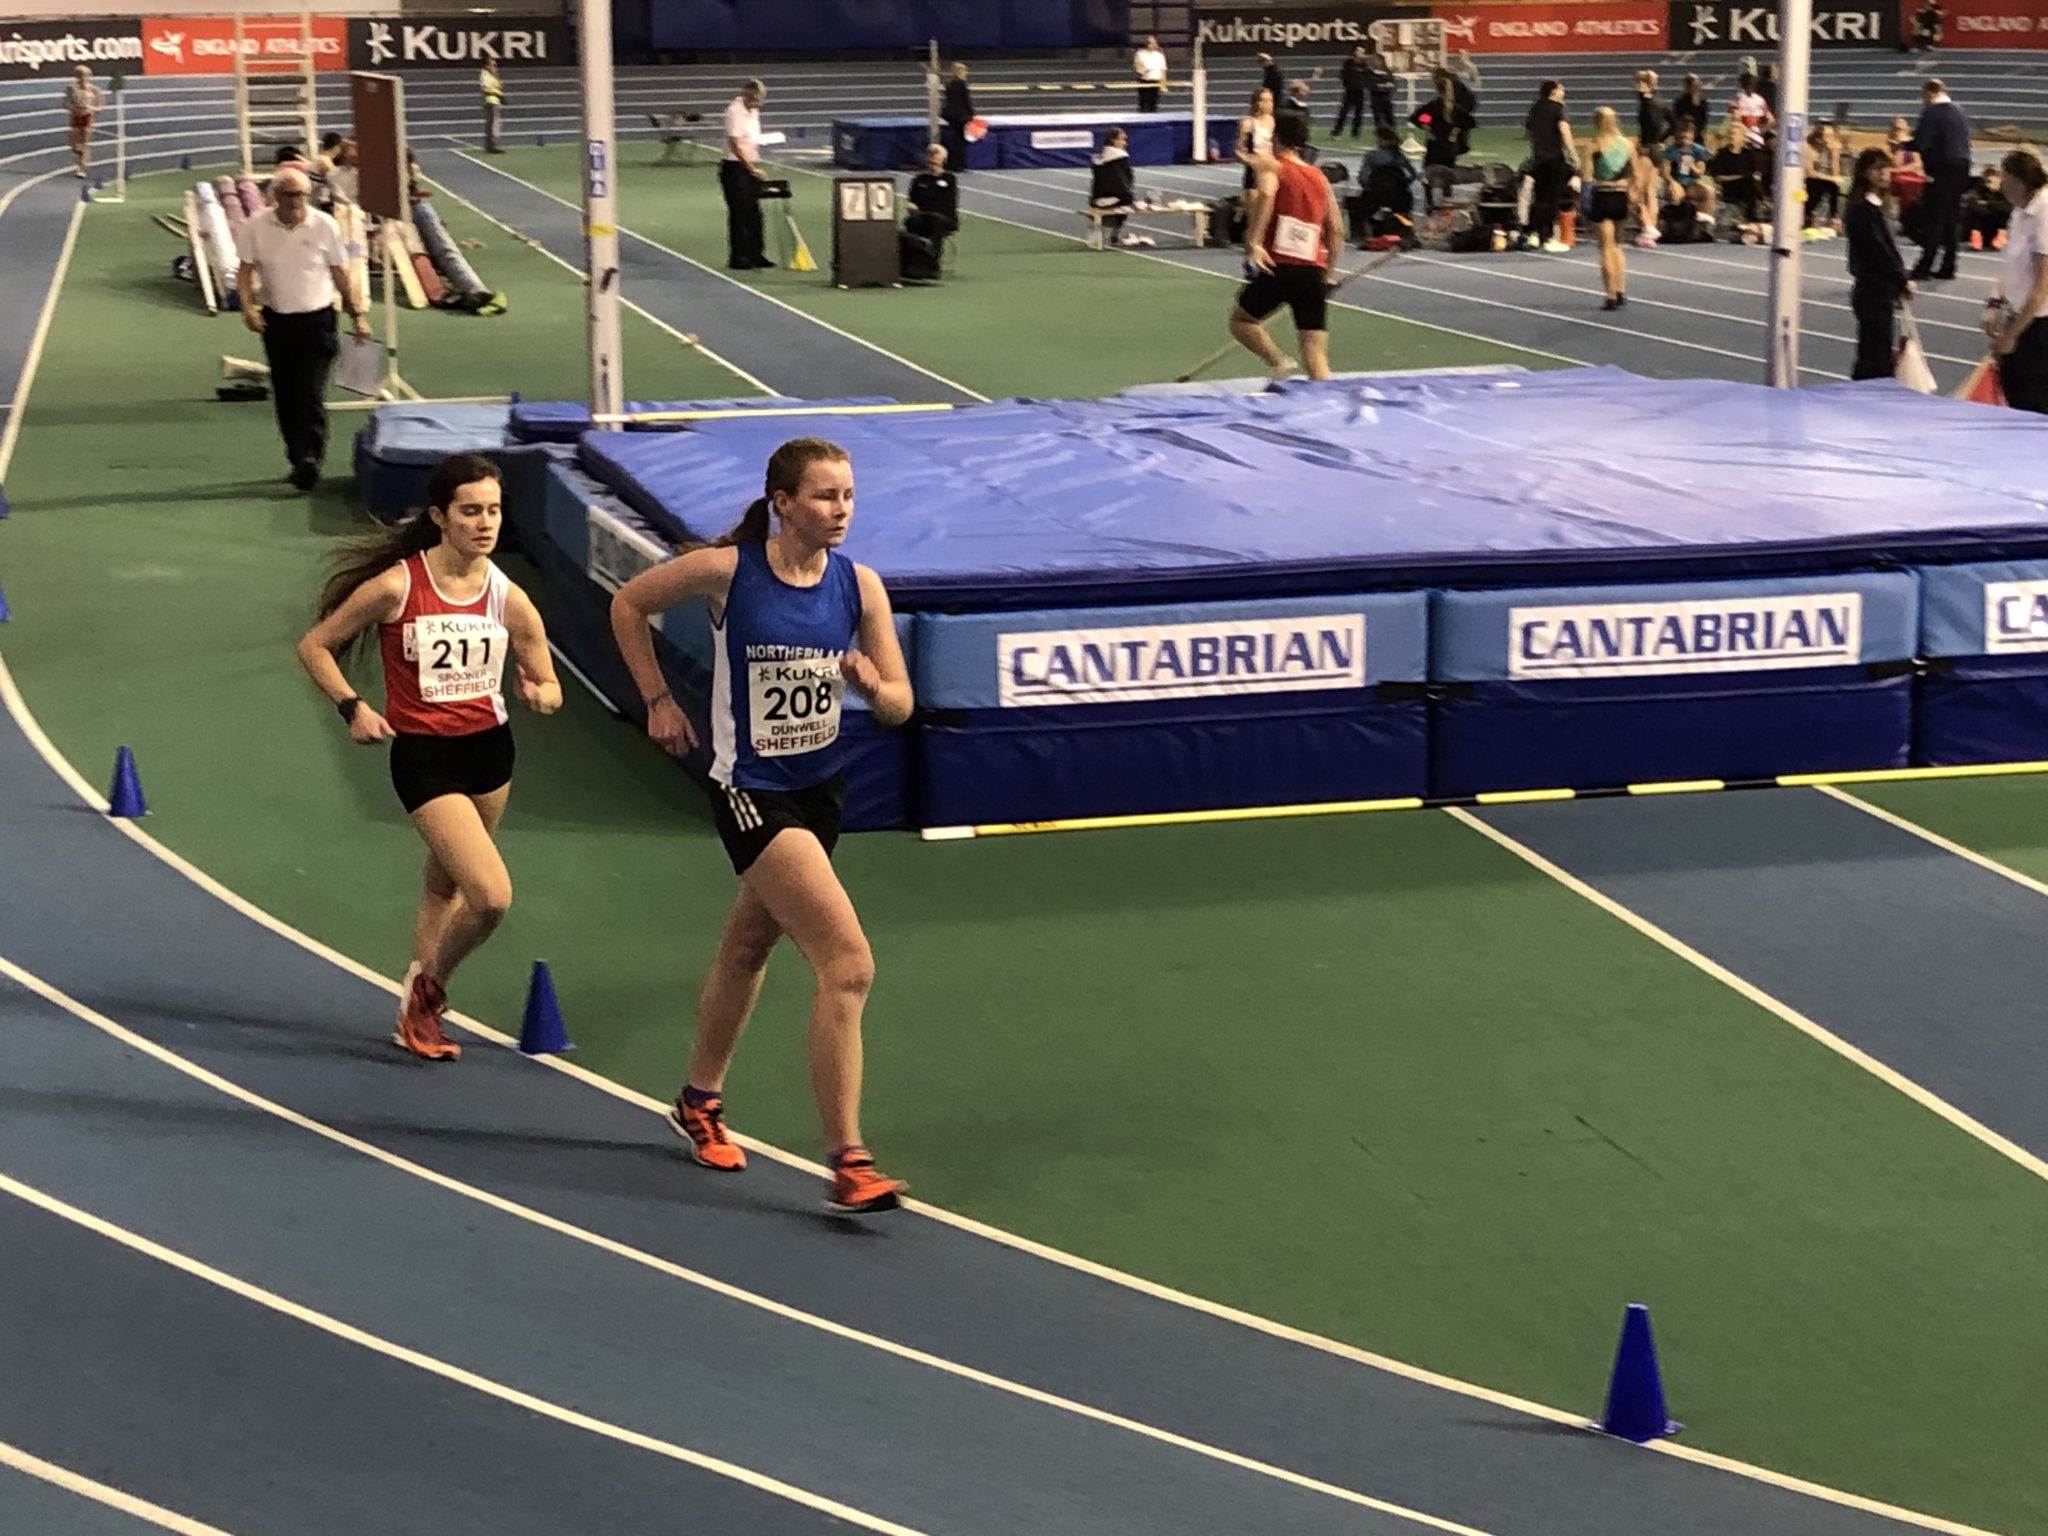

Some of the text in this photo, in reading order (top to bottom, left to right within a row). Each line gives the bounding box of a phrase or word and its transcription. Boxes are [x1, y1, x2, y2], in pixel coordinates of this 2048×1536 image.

[1488, 20, 1660, 37] ENGLAND ATHLETICS
[1956, 16, 2033, 32] ENGLAND
[402, 25, 547, 61] KUKRI
[1521, 606, 1850, 660] CANTABRIAN
[431, 637, 491, 669] 211
[746, 644, 824, 660] NORTHERN
[1013, 628, 1353, 687] CANTABRIAN
[438, 669, 487, 683] SPOONER
[424, 678, 497, 698] SHEFFIELD
[763, 682, 832, 721] 208
[755, 725, 836, 751] SHEFFIELD
[771, 719, 828, 736] DUNWELL
